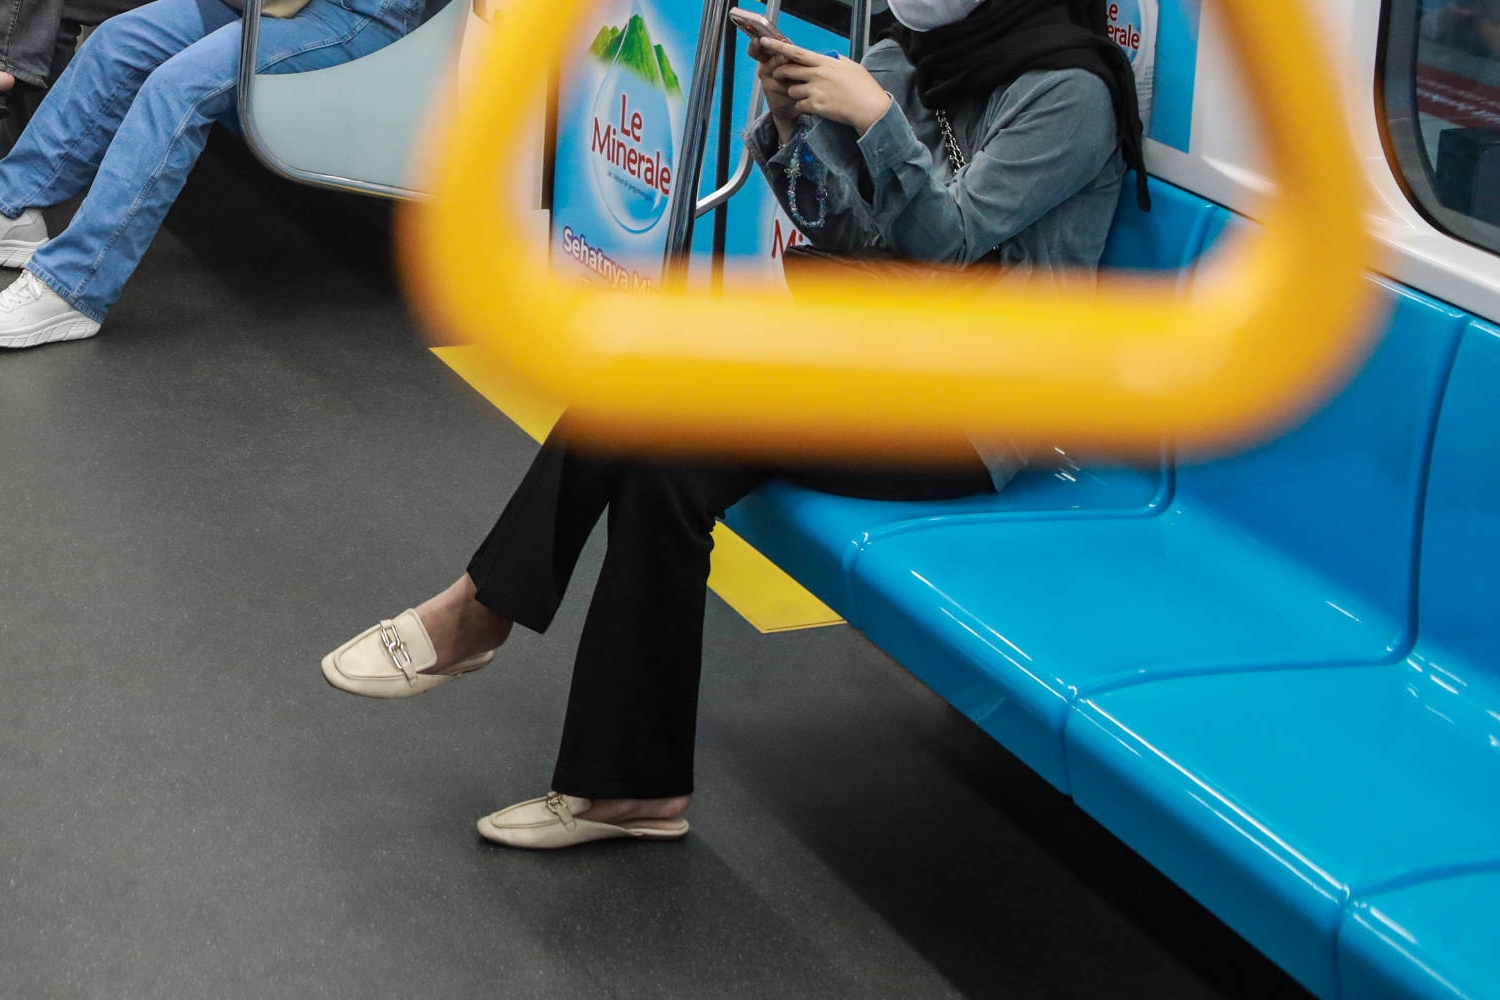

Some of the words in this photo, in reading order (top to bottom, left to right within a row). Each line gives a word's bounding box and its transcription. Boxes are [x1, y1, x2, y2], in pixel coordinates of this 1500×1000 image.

[620, 93, 643, 143] Le
[591, 116, 672, 196] Minerale
[562, 226, 630, 293] Sehatnya
